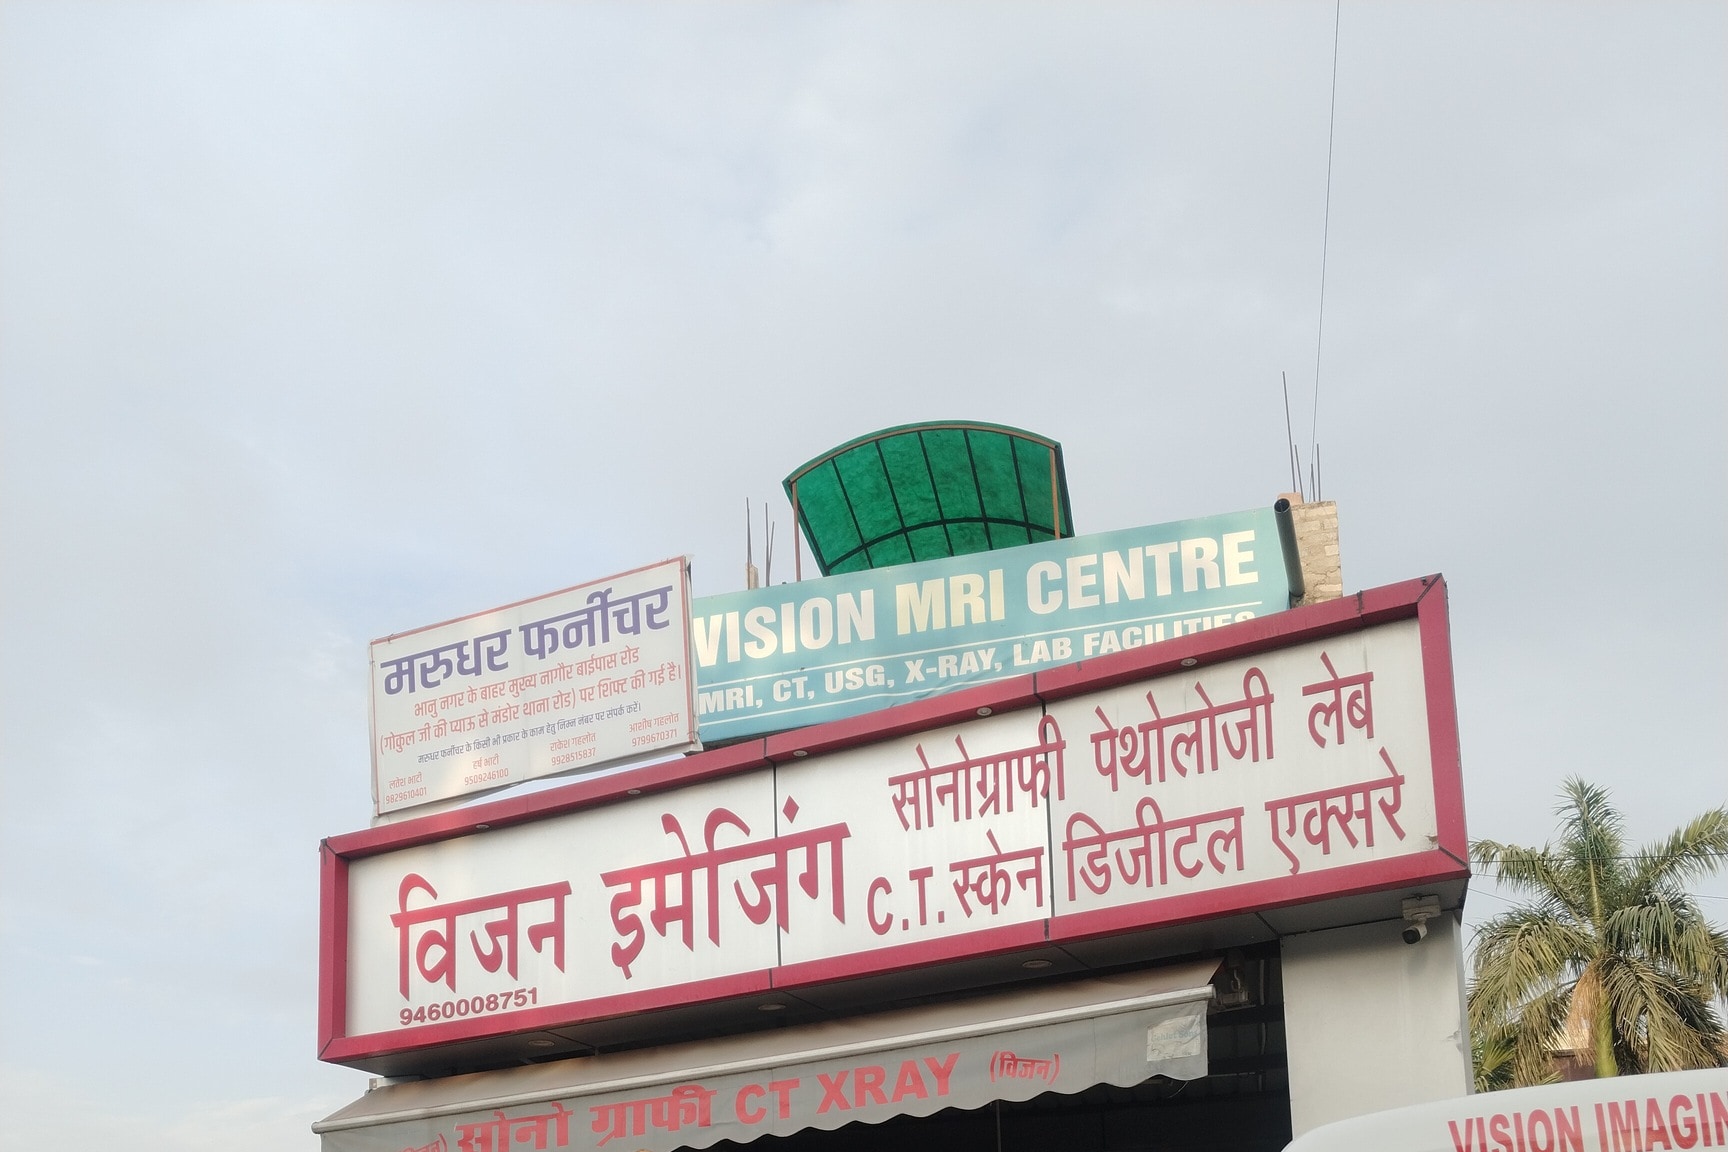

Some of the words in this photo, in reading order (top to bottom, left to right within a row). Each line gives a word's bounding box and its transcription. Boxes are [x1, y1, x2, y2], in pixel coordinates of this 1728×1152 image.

[380, 629, 512, 696] मरुधर
[519, 585, 673, 660] फर्नीचर
[693, 588, 875, 668] VISION
[895, 569, 1004, 637] MRI
[1026, 530, 1260, 615] CENTRE
[380, 730, 415, 755] (गोकुल
[418, 722, 431, 742] जी
[433, 718, 447, 738] की
[449, 715, 476, 733] प्याऊ
[478, 708, 489, 728] से
[491, 702, 520, 724] मंडोर
[523, 696, 550, 717] थाना
[552, 687, 576, 710] रोड)
[579, 685, 595, 703] पर
[598, 677, 628, 699] शिफ्ट
[630, 669, 645, 690] की
[649, 666, 665, 687] गई
[414, 699, 438, 718] भानु
[440, 691, 465, 710] नगर
[467, 685, 478, 704] के
[480, 681, 506, 700] बाहर
[509, 673, 537, 698] मुख्य
[541, 662, 574, 685] नागौर
[576, 652, 617, 676] बाईपास
[620, 645, 640, 666] रोड
[594, 711, 605, 722] पर
[698, 685, 763, 715] MRI,
[772, 675, 814, 703] CT,
[824, 664, 895, 694] USG,
[905, 646, 1002, 684] X-RAY,
[1014, 636, 1072, 666] LAB
[464, 767, 509, 786] 9509246100
[551, 747, 596, 766] 9928515837
[888, 714, 1066, 832] सोनोग्राफी
[1090, 666, 1275, 792] पेथोलोजी
[1302, 650, 1374, 749] लेब
[1062, 796, 1245, 901] डिजीटल
[1265, 747, 1406, 874] एक्सरे
[390, 872, 572, 1001] विजन
[600, 795, 851, 980] इमेजिंग
[399, 987, 539, 1026] 9460008751
[590, 1085, 717, 1148] ग्राफी
[735, 1078, 800, 1125] CT
[816, 1052, 961, 1114] XRAY
[990, 1050, 1060, 1085] (विजन)
